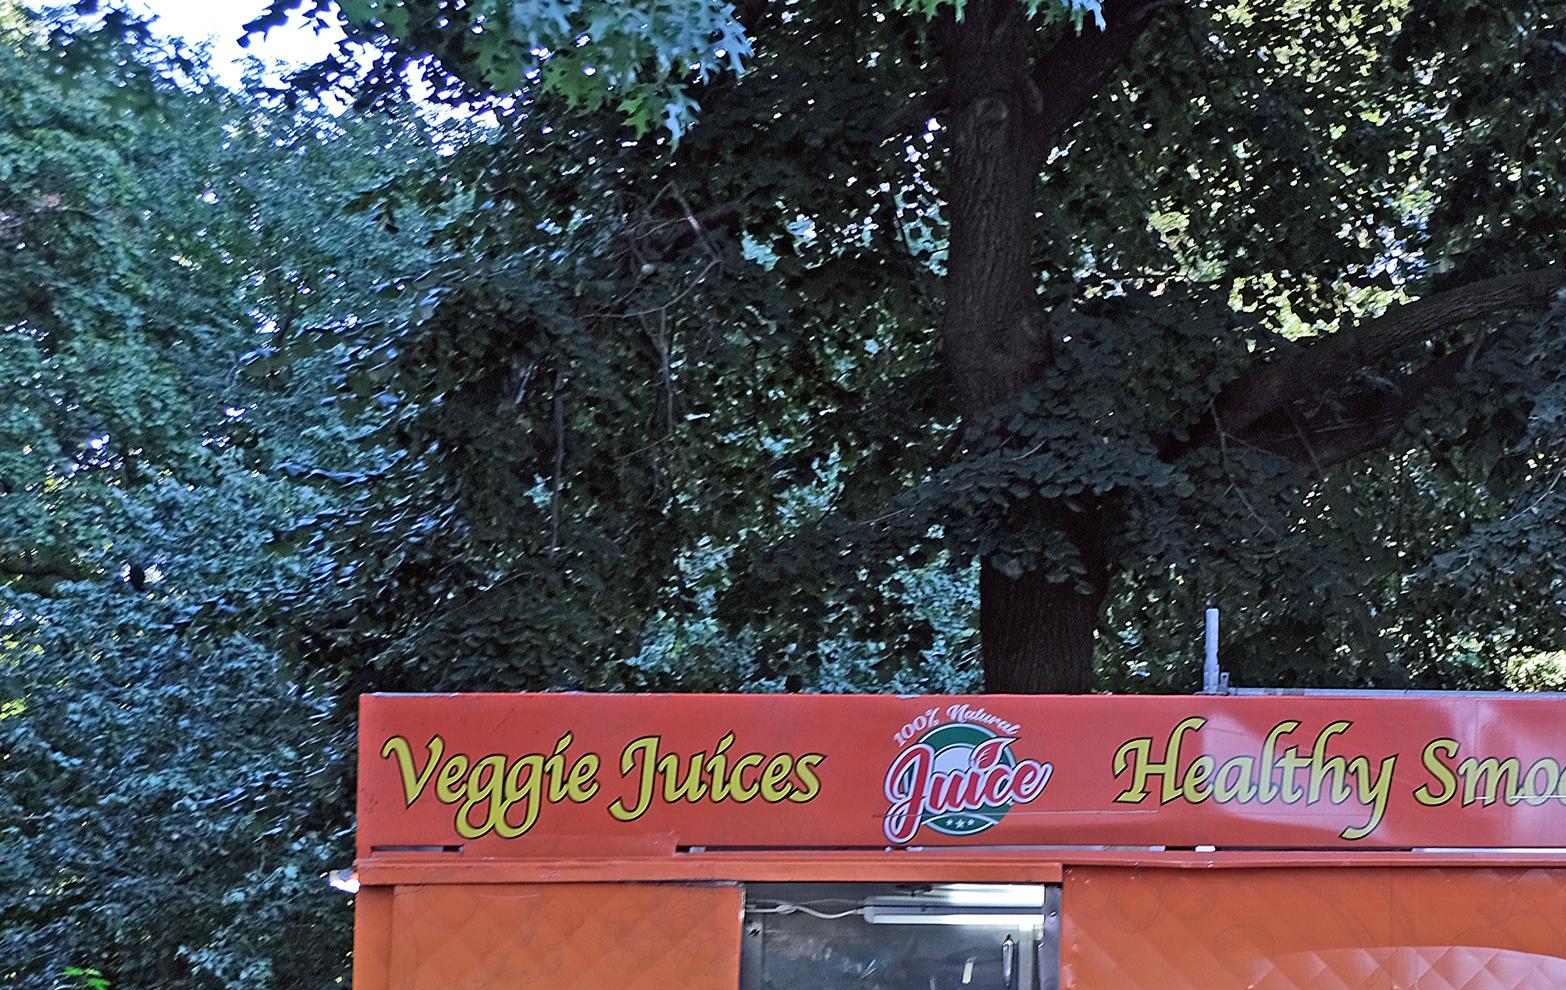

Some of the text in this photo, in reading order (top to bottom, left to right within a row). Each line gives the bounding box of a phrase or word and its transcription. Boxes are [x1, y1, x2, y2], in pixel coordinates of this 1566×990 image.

[893, 704, 1022, 747] 100% Natural
[1111, 715, 1399, 841] Healthy
[379, 730, 827, 840] Veggie Juices
[884, 744, 1054, 844] Juice
